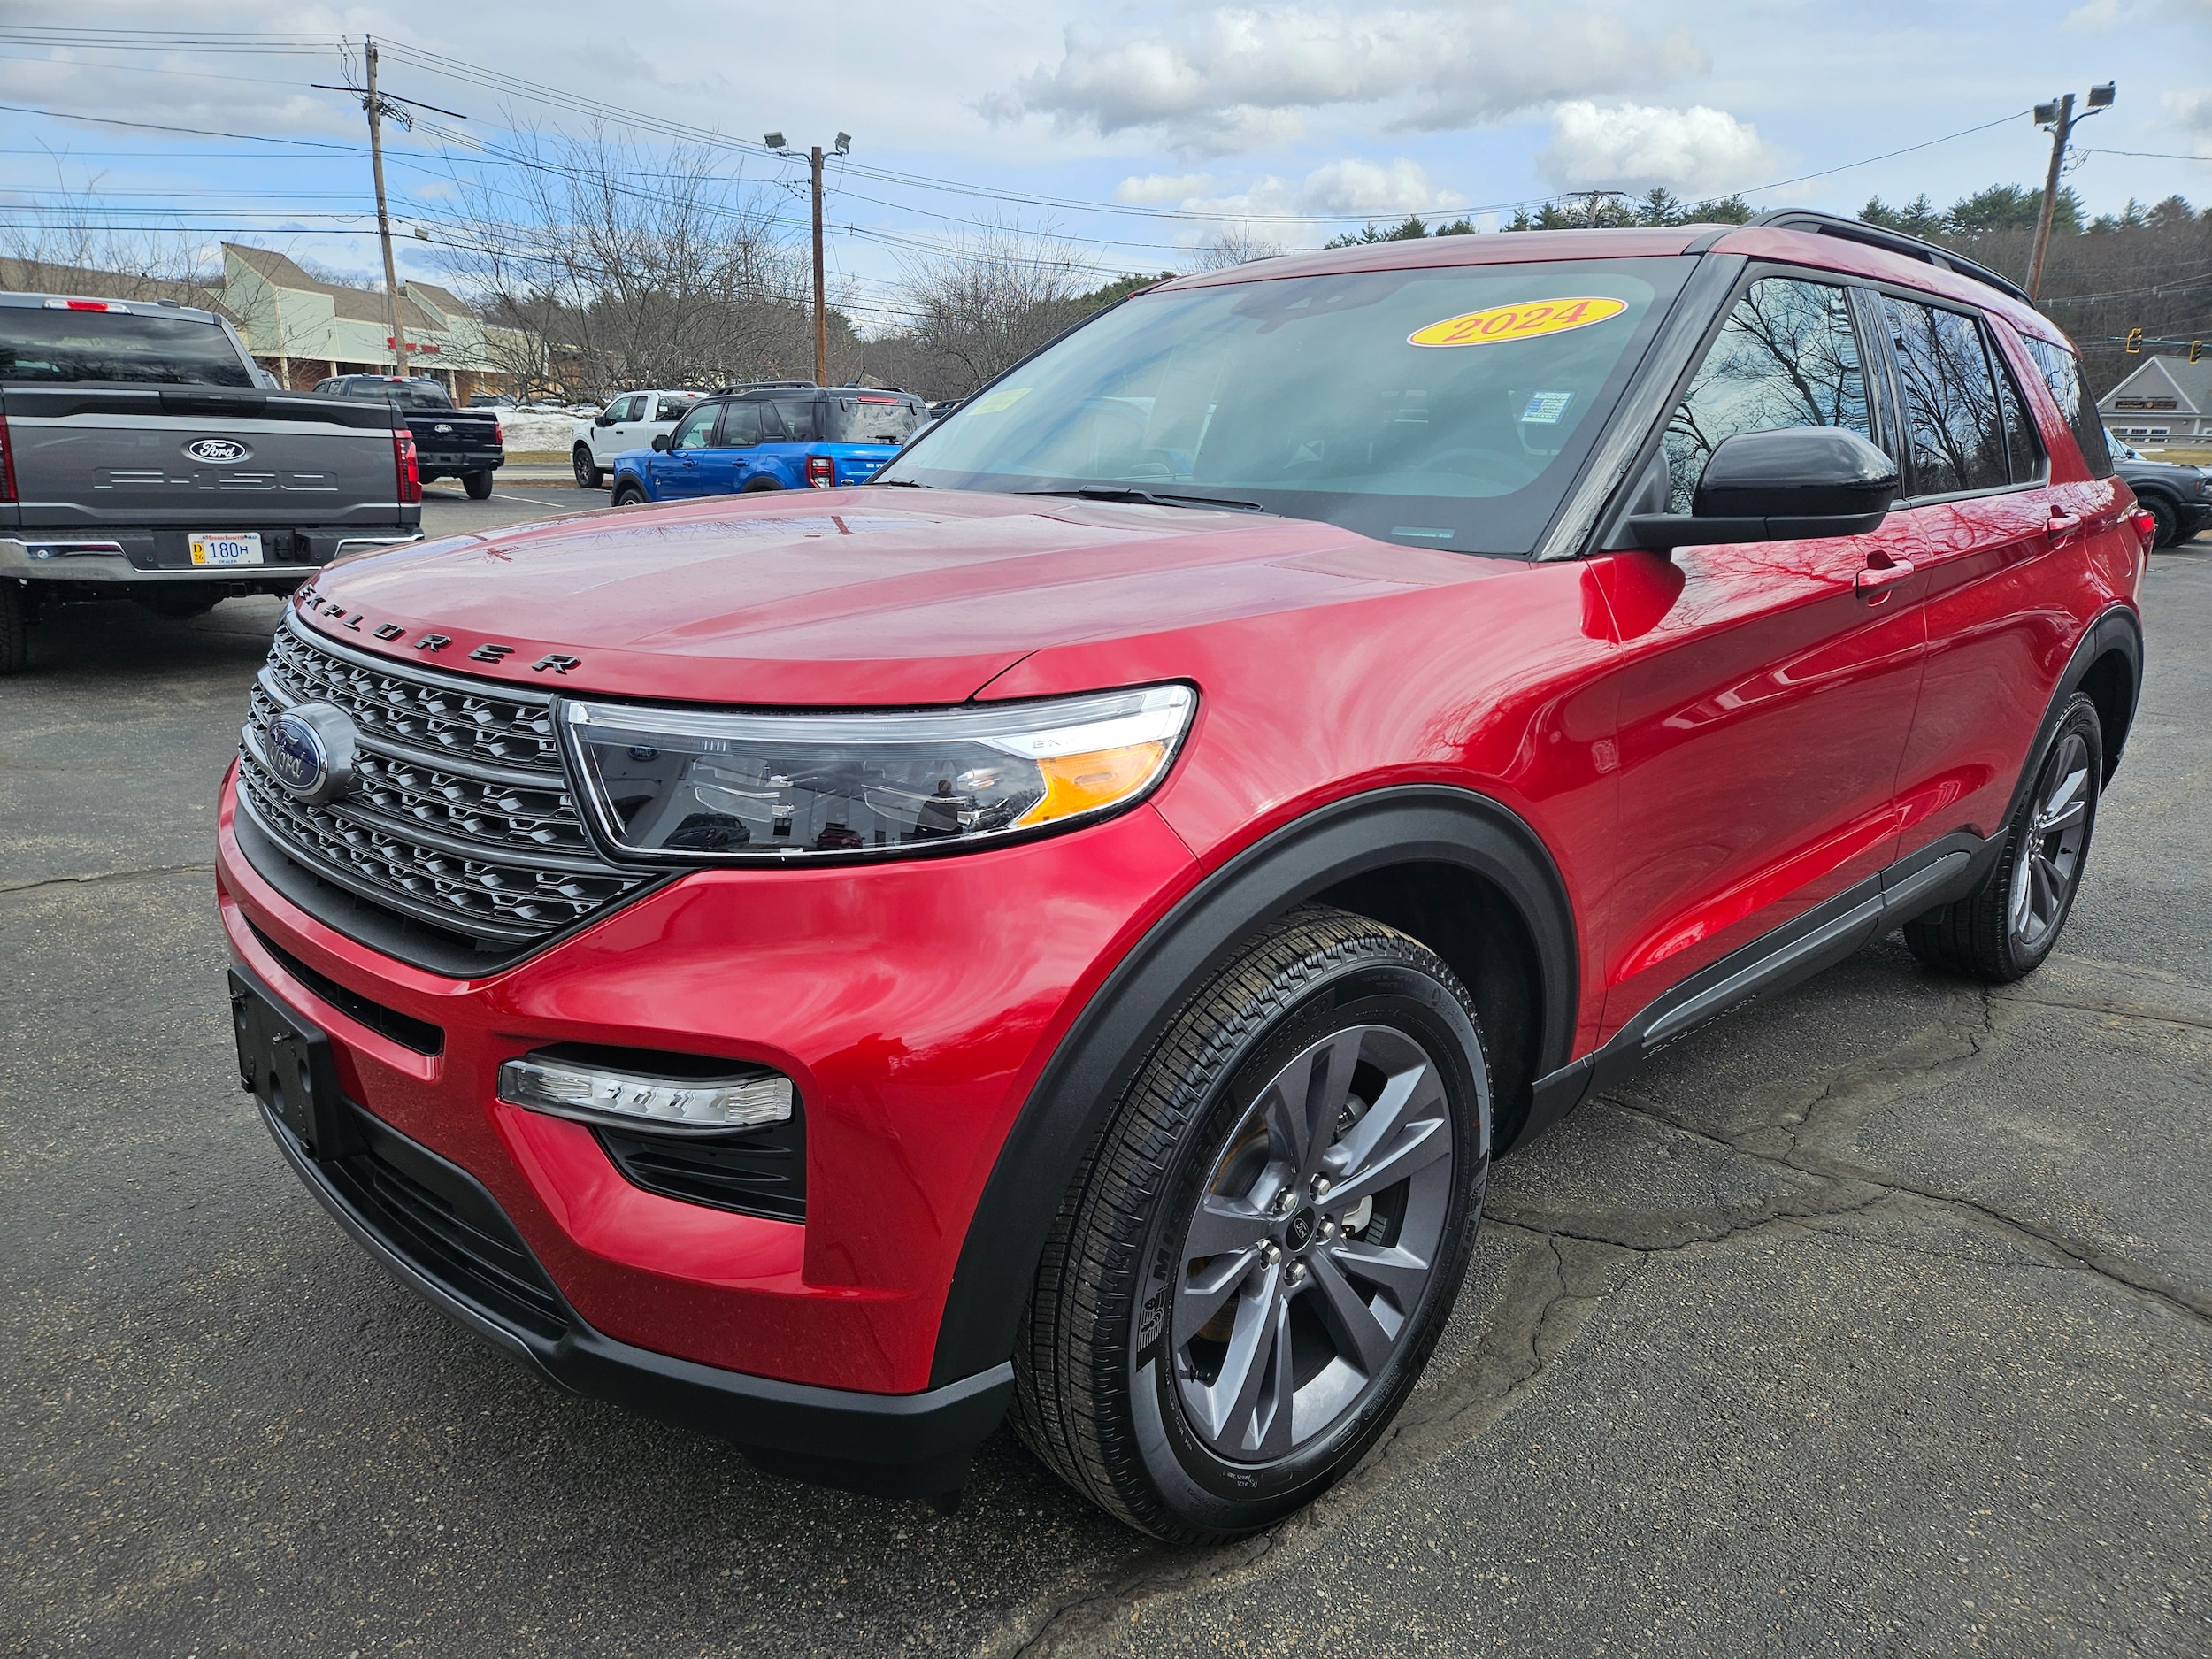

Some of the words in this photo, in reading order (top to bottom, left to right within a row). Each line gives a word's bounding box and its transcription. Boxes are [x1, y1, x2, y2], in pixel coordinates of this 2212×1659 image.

[1442, 301, 1591, 342] 2024
[197, 441, 237, 458] Ford
[93, 467, 339, 491] F-150
[193, 544, 203, 553] D
[210, 542, 249, 558] 180H
[299, 583, 582, 675] EXPLORER
[1152, 1095, 1240, 1282] MICHELIN
